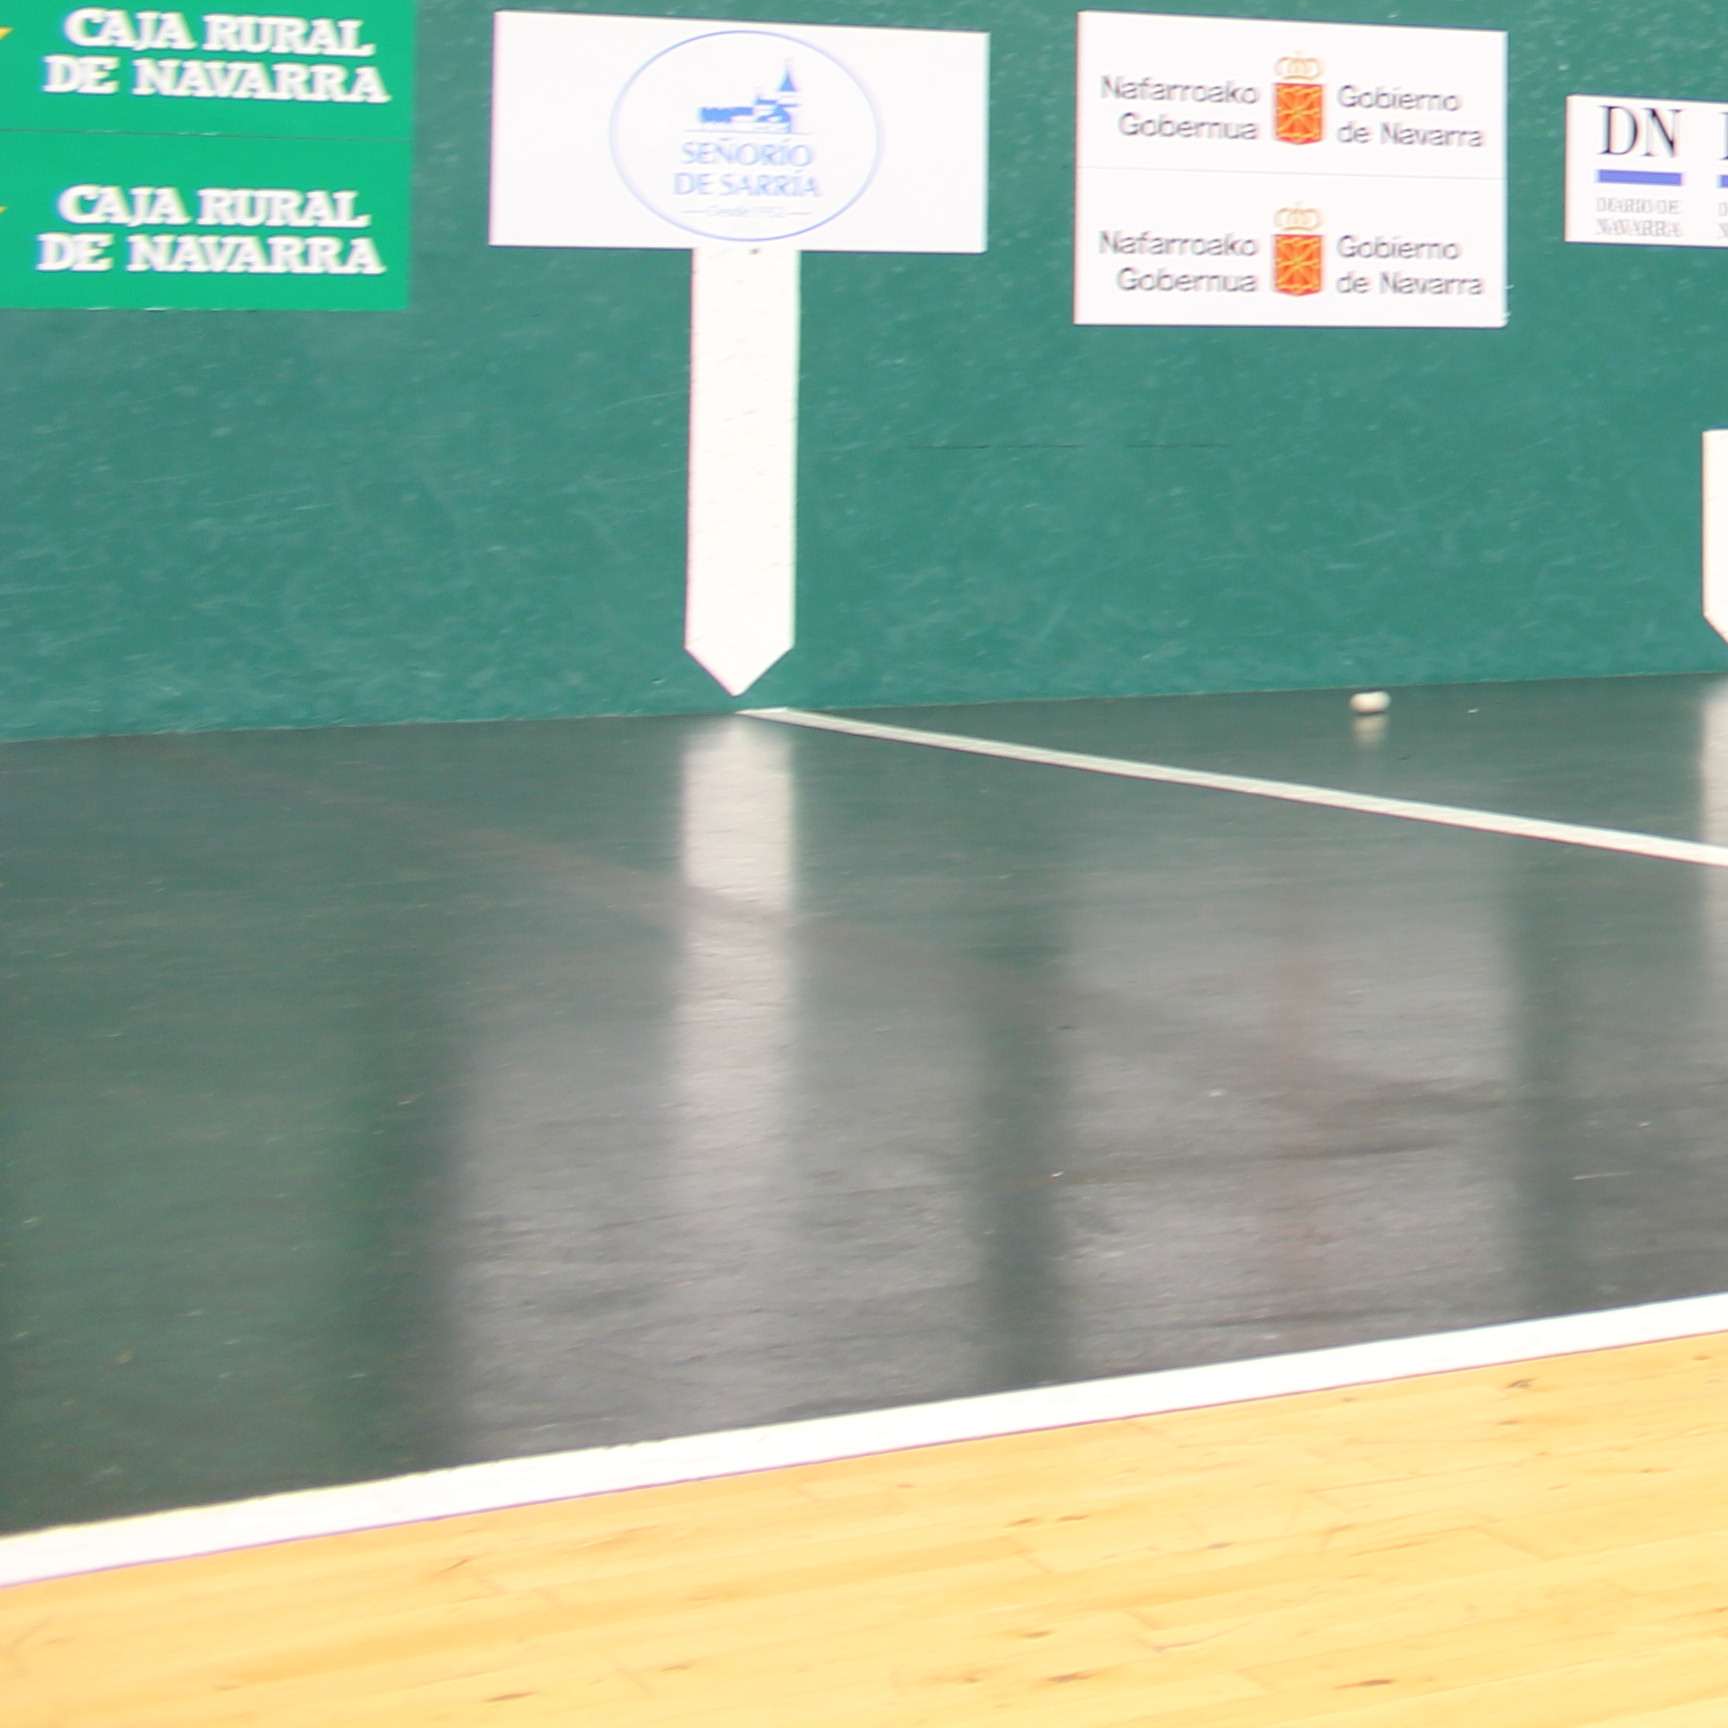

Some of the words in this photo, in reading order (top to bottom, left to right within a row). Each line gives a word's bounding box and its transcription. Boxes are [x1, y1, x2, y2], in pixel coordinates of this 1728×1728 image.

[63, 6, 198, 52] CAJA
[202, 13, 377, 57] RURAL
[42, 53, 121, 95] DE
[131, 57, 393, 105] NAVARRA
[1099, 74, 1260, 105] Nafarroako
[1337, 85, 1462, 112] Gobierno
[1118, 112, 1258, 141] Gobernua
[1336, 122, 1371, 144] de
[1380, 122, 1484, 148] Navarra
[1597, 105, 1685, 159] DN
[680, 137, 814, 167] SEÑORÍO
[672, 172, 716, 195] DE
[719, 169, 823, 197] SARRÍA
[56, 183, 192, 228] CAJA
[195, 187, 373, 229] RURAL
[1596, 197, 1653, 214] DIARIO
[1657, 199, 1682, 216] DE
[1596, 218, 1683, 239] NAVARRA
[35, 231, 115, 272] DE
[125, 234, 388, 276] NAVARRA
[1098, 230, 1259, 258] Nafarroako
[1336, 235, 1462, 260] Gobierno
[1116, 267, 1258, 293] Gobernua
[1335, 272, 1371, 295] de
[1379, 272, 1484, 296] Navarra
